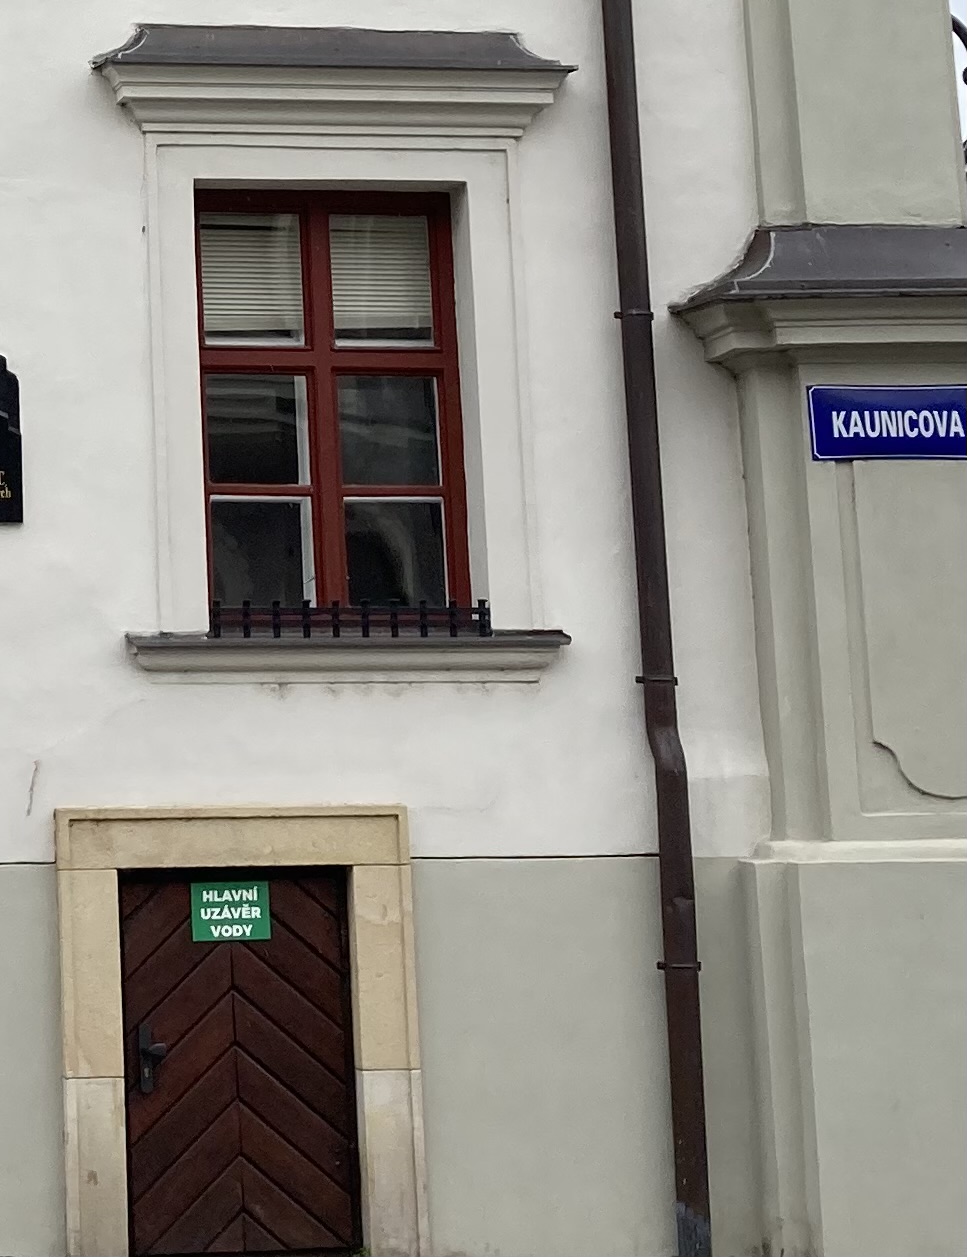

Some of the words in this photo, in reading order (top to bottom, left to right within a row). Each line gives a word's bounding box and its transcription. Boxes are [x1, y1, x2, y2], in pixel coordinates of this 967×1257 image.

[832, 410, 965, 437] KAUNICOVA
[202, 886, 258, 902] HLAVNÍ
[200, 904, 261, 920] UZÁVĚR
[210, 924, 253, 937] VODY
